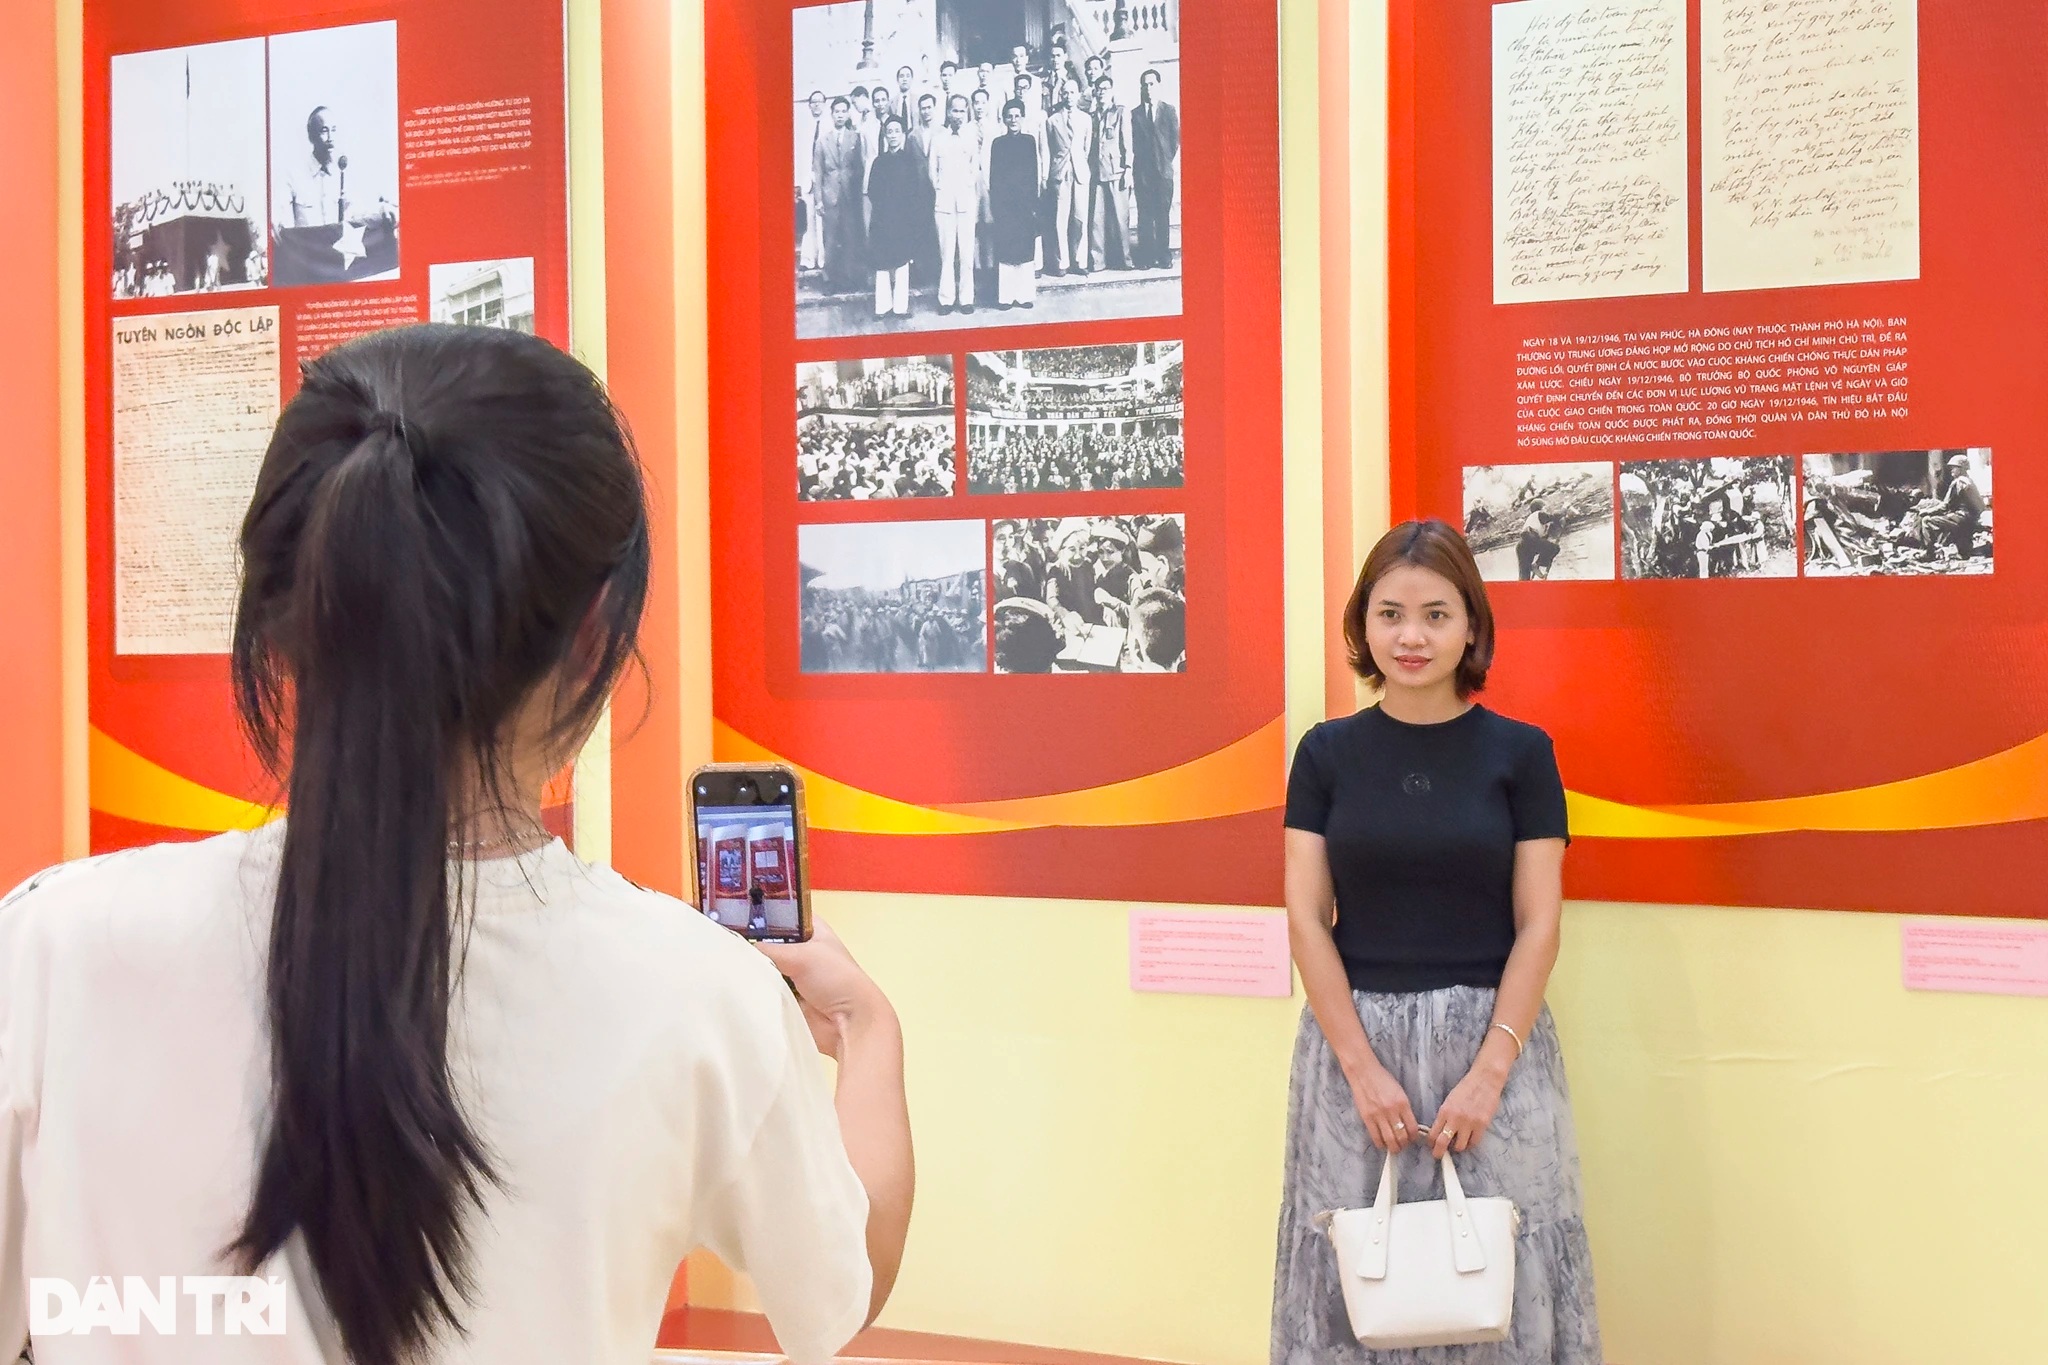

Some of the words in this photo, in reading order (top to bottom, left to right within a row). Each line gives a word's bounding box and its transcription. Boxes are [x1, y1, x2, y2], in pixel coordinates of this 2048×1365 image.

[117, 327, 157, 344] TUYÊN
[165, 323, 206, 340] NGÔN
[213, 319, 242, 338] ĐỘC
[250, 316, 273, 334] LẬP
[1522, 337, 1545, 347] NGÀY
[1548, 337, 1558, 346] 18
[1560, 335, 1571, 345] VÀ
[1688, 328, 1701, 337] HÀ
[1703, 326, 1730, 337] ĐÔNG
[1756, 323, 1786, 334] THUỘC
[1789, 321, 1820, 331] THÀNH
[1823, 319, 1843, 330] PHỐ
[1846, 318, 1859, 329] HÀ
[1887, 317, 1906, 326] BAN
[1553, 351, 1565, 360] VỤ
[1567, 349, 1595, 358] TRUNG
[1625, 345, 1650, 356] ĐẢNG
[1652, 345, 1671, 355] HỌP
[1690, 342, 1715, 353] RỘNG
[1717, 341, 1731, 350] DO
[1733, 338, 1752, 350] CHỦ
[1755, 339, 1775, 349] TỊCH
[1794, 336, 1809, 346] CHÍ
[1812, 336, 1835, 345] MINH
[1838, 333, 1858, 344] CHỦ
[1894, 332, 1907, 341] RA
[1566, 362, 1593, 374] QUYẾT
[1633, 360, 1658, 369] NƯỚC
[1660, 358, 1684, 368] BƯỚC
[1687, 357, 1705, 367] VÀO
[1707, 355, 1732, 366] CUỘC
[1734, 354, 1765, 364] KHÁNG
[1768, 352, 1794, 363] CHIẾN
[1796, 351, 1829, 361] CHỐNG
[1860, 348, 1880, 358] DÂN
[1883, 346, 1907, 356] PHÁP
[1516, 380, 1535, 390] XÂM
[1598, 376, 1621, 385] NGÀY
[1679, 372, 1691, 382] BỘ
[1696, 369, 1732, 381] TRƯỞNG
[1737, 369, 1750, 380] BỘ
[1755, 367, 1781, 379] QUỐC
[1787, 366, 1819, 376] PHÒNG
[1843, 363, 1880, 373] NGUYÊN
[1885, 361, 1907, 372] GIÁP
[1516, 393, 1543, 404] QUYẾT
[1605, 390, 1623, 400] ĐẾN
[1626, 389, 1643, 399] CÁC
[1646, 389, 1666, 398] ĐƠN
[1680, 387, 1697, 397] LỰC
[1700, 385, 1731, 395] LƯỢNG
[1749, 383, 1779, 393] TRANG
[1805, 380, 1828, 392] LỆNH
[1846, 378, 1871, 388] NGÀY
[1874, 377, 1887, 387] VÀ
[1516, 407, 1534, 418] CỦA
[1537, 407, 1560, 417] CUỘC
[1564, 407, 1584, 416] GIAO
[1588, 405, 1612, 415] CHIẾN
[1616, 404, 1645, 413] TRONG
[1648, 402, 1672, 412] TOÀN
[1707, 401, 1717, 410] 20
[1740, 398, 1765, 408] NGÀY
[1822, 395, 1836, 404] TÍN
[1841, 394, 1862, 405] HIỆU
[1887, 391, 1907, 402] ĐẦU
[1517, 422, 1546, 432] KHÁNG
[1549, 420, 1573, 431] CHIẾN
[1578, 421, 1600, 430] TOÀN
[1604, 418, 1628, 429] QUỐC
[1632, 418, 1658, 428] ĐƯỢC
[1662, 416, 1684, 426] PHÁT
[1705, 414, 1732, 425] ĐỒNG
[1760, 412, 1787, 423] QUÂN
[1790, 410, 1803, 421] VÀ
[1807, 410, 1827, 420] DÂN
[1831, 408, 1850, 419] THỦ
[1854, 408, 1869, 419] ĐÔ
[1873, 407, 1886, 418] HÀ
[1891, 406, 1908, 418] NỘI
[1531, 436, 1554, 446] SÚNG
[1570, 434, 1589, 444] ĐẦU
[1590, 433, 1613, 444] CUỘC
[1615, 433, 1644, 443] KHÁNG
[1645, 431, 1671, 441] CHIẾN
[1672, 430, 1702, 440] TRONG
[1702, 429, 1727, 439] TOÀN
